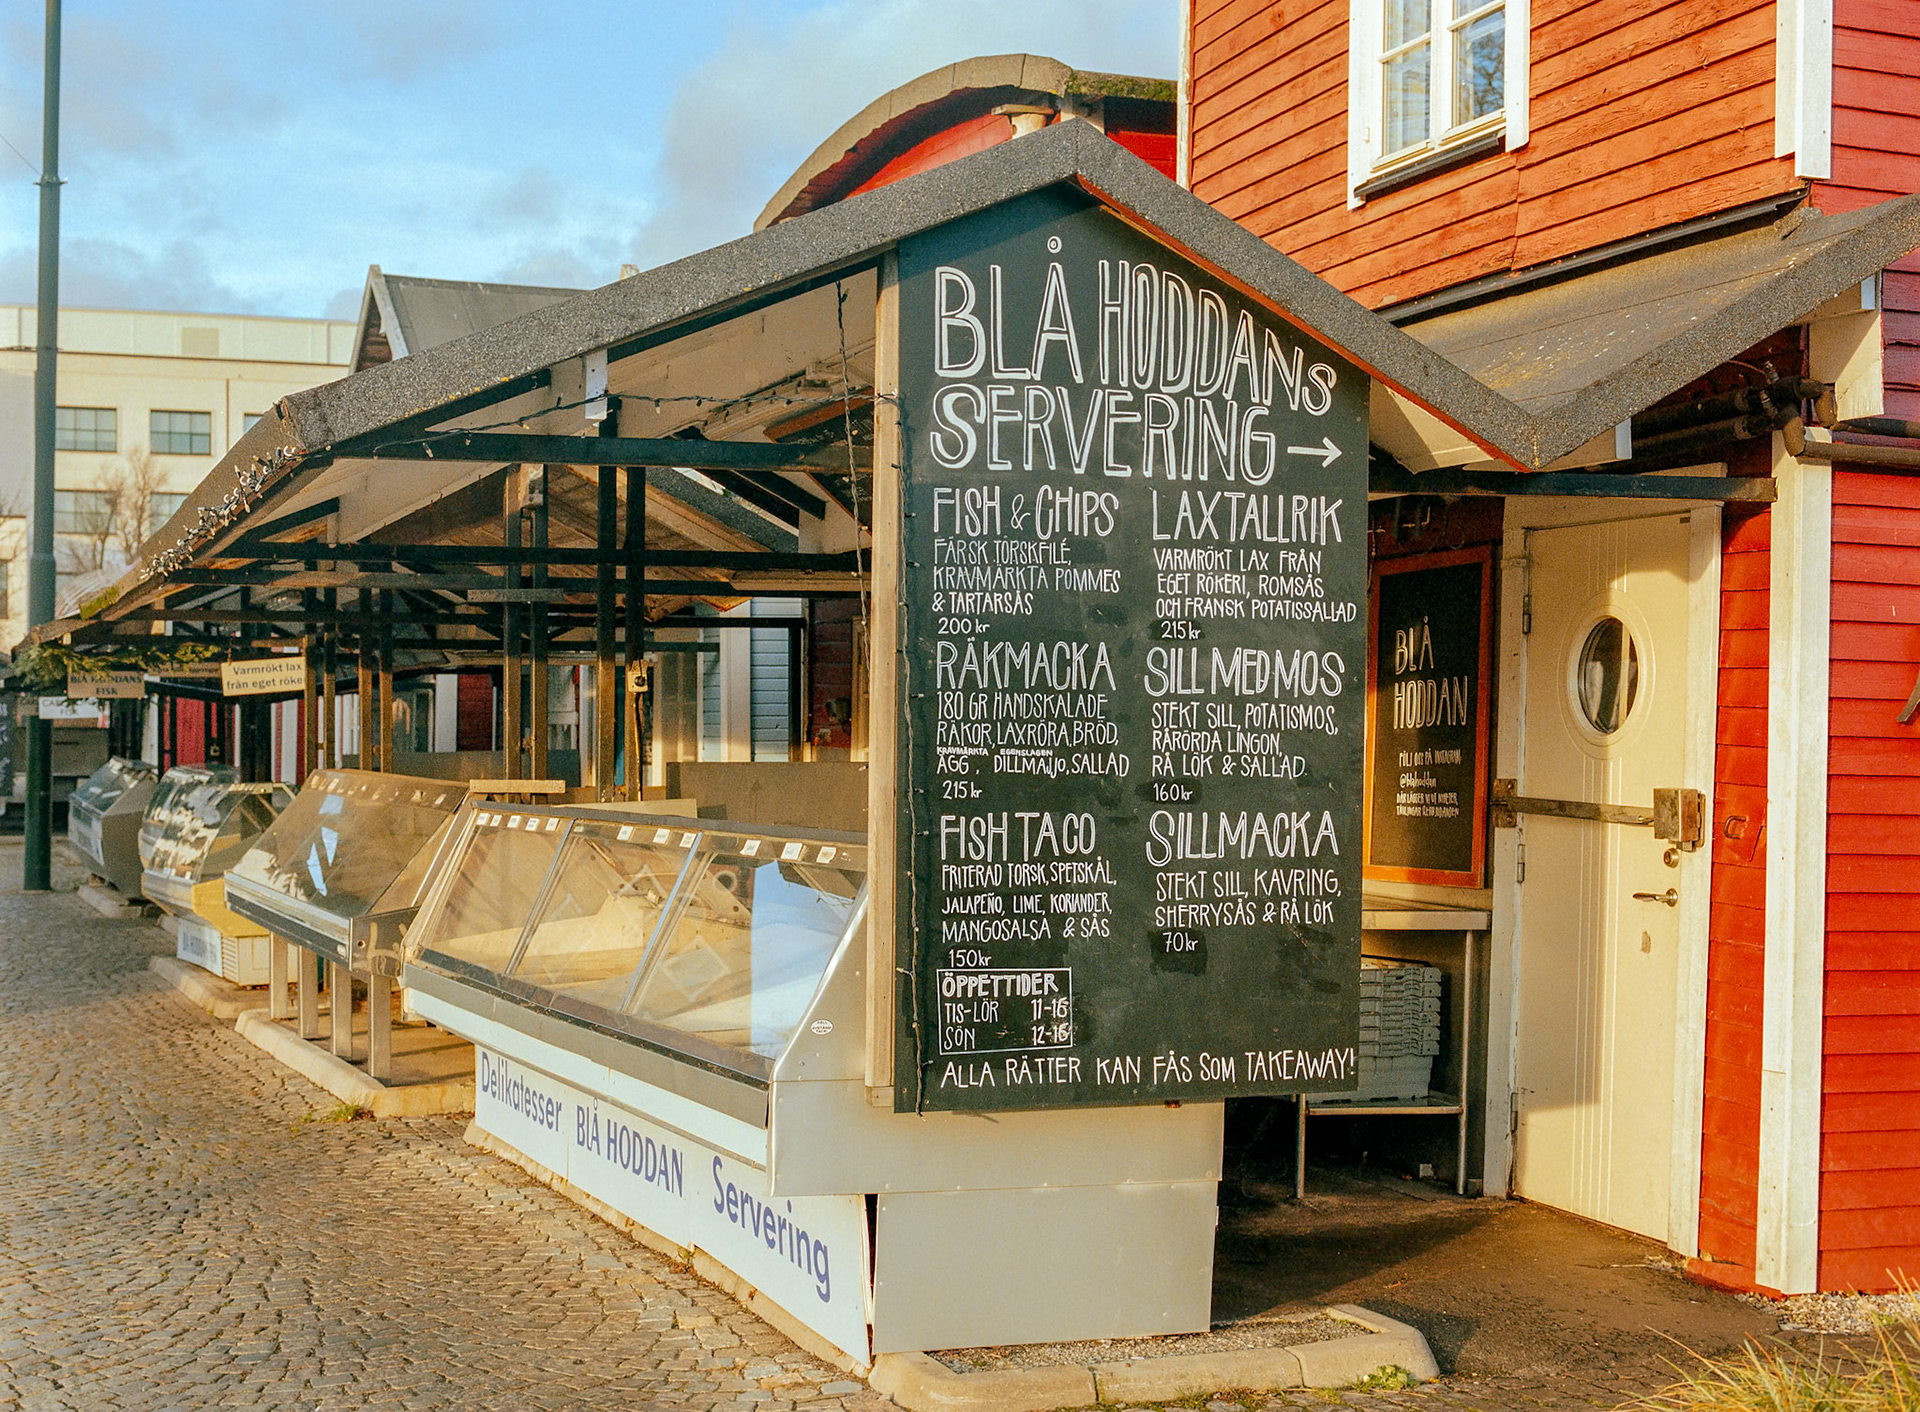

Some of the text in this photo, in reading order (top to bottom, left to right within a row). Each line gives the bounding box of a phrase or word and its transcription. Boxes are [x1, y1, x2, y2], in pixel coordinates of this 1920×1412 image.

[935, 236, 1338, 416] BLÅ HODDANS
[930, 384, 1276, 486] SERVERING
[934, 486, 1000, 537] FISH
[1011, 494, 1030, 530] &
[1036, 485, 1119, 540] CHIPS
[1153, 490, 1342, 545] LAXTALLRIK
[935, 536, 1072, 566] FÄRSK TORSKFILÉ,
[1153, 546, 1321, 574] VARMRÖKT LAX FRÅN
[934, 565, 1121, 593] KRAVMÄRKTA POMMES
[1158, 572, 1324, 599] EGET RÖKERI, ROMSÅS
[932, 591, 1034, 615] & TARTARSÅS
[1156, 597, 1357, 622] OCH FRANSK POTATISSALLAD
[1395, 615, 1434, 675] BLÅ
[233, 663, 302, 675] Varmrökt lax
[937, 637, 1116, 690] RÄKMACKA
[1144, 647, 1204, 697] SILL
[227, 680, 249, 690] från
[252, 678, 276, 689] eget
[937, 691, 1108, 720] 180 GR HANDSKALADE
[1393, 675, 1468, 730] HODDAN
[1073, 720, 1119, 746] BRÖD,
[1152, 702, 1338, 735] STEKT SILL, POTATISMOS,
[1152, 728, 1283, 757] RÅRÖRDA LINGON,
[1071, 752, 1130, 777] SALLAD
[1152, 752, 1306, 779] RÅ LÖK & SALLAD
[941, 812, 1096, 862] FISH TACO
[1146, 810, 1339, 867] SILLMACKA
[942, 856, 1117, 891] FRITERAD TORSK, SPETSKÅL,
[1156, 868, 1342, 901] STEKT SILL, KAVRING,
[941, 892, 1113, 917] JALAPEÑO, LIME, KORIANDER,
[1155, 898, 1334, 928] SHERRYSÅS & RÅ LÖK
[942, 913, 1110, 943] MANGOSALSA & SÅS
[941, 972, 1059, 998] ÖPPETTIDER
[945, 998, 999, 1024] TIS-LÖR
[944, 1026, 975, 1050] SÖN
[941, 1048, 1355, 1088] ALLA RÄTTER KAN FÅS SOM TAKEAWAY!
[482, 1051, 563, 1133] Delikatesser
[606, 1118, 683, 1198] HODDAN
[712, 1155, 830, 1302] Servering
